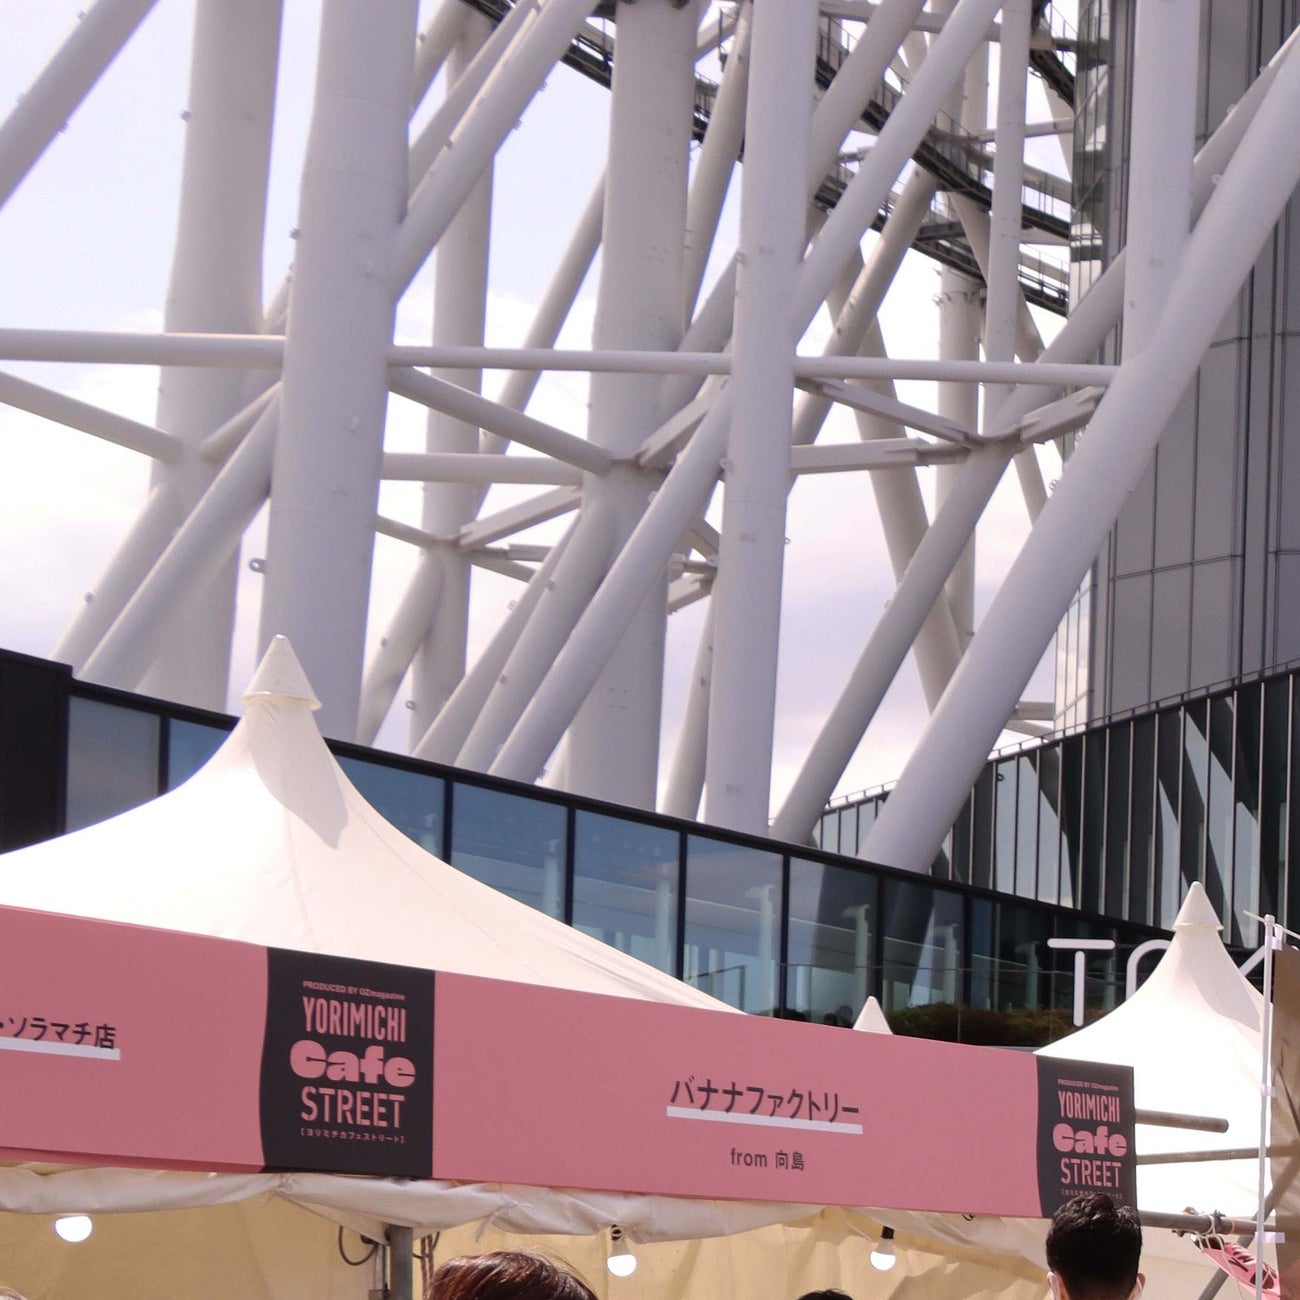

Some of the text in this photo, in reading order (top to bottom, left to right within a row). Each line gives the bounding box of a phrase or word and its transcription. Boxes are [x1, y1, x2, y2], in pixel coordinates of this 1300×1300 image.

[303, 981, 346, 994] PRODUCED
[349, 987, 358, 995] BY
[302, 996, 406, 1042] YORIMICHI
[290, 1040, 416, 1087] Cafe
[301, 1086, 405, 1128] STREET
[671, 1075, 859, 1122] バナナファクトリー
[1058, 1091, 1120, 1122] YORIMICHI
[1052, 1123, 1127, 1156] Cafe
[731, 1148, 804, 1170] from 向島
[1061, 1157, 1121, 1187] STREET
